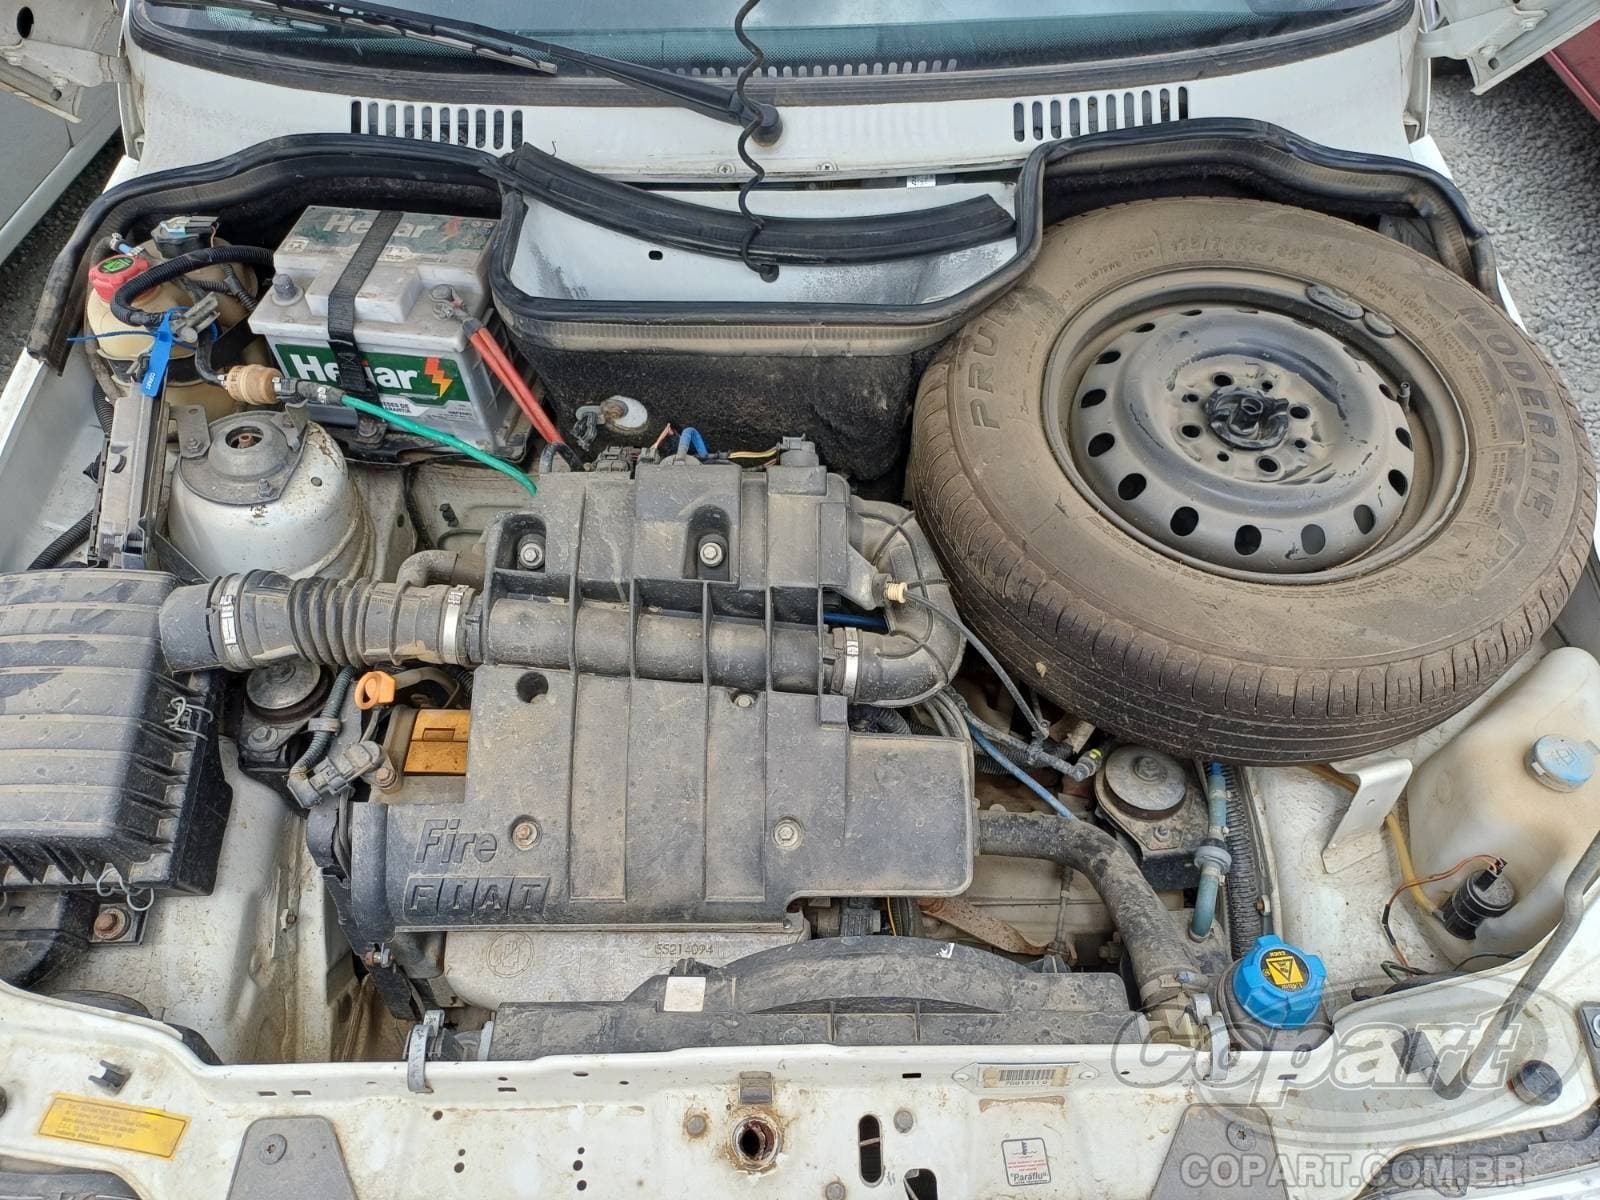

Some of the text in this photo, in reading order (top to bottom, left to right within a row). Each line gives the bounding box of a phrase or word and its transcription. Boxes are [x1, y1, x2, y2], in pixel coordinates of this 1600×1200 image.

[1456, 306, 1561, 519] MODERATE
[415, 818, 498, 863] Fire
[408, 883, 542, 911] FIAT
[654, 943, 714, 956] 55214094
